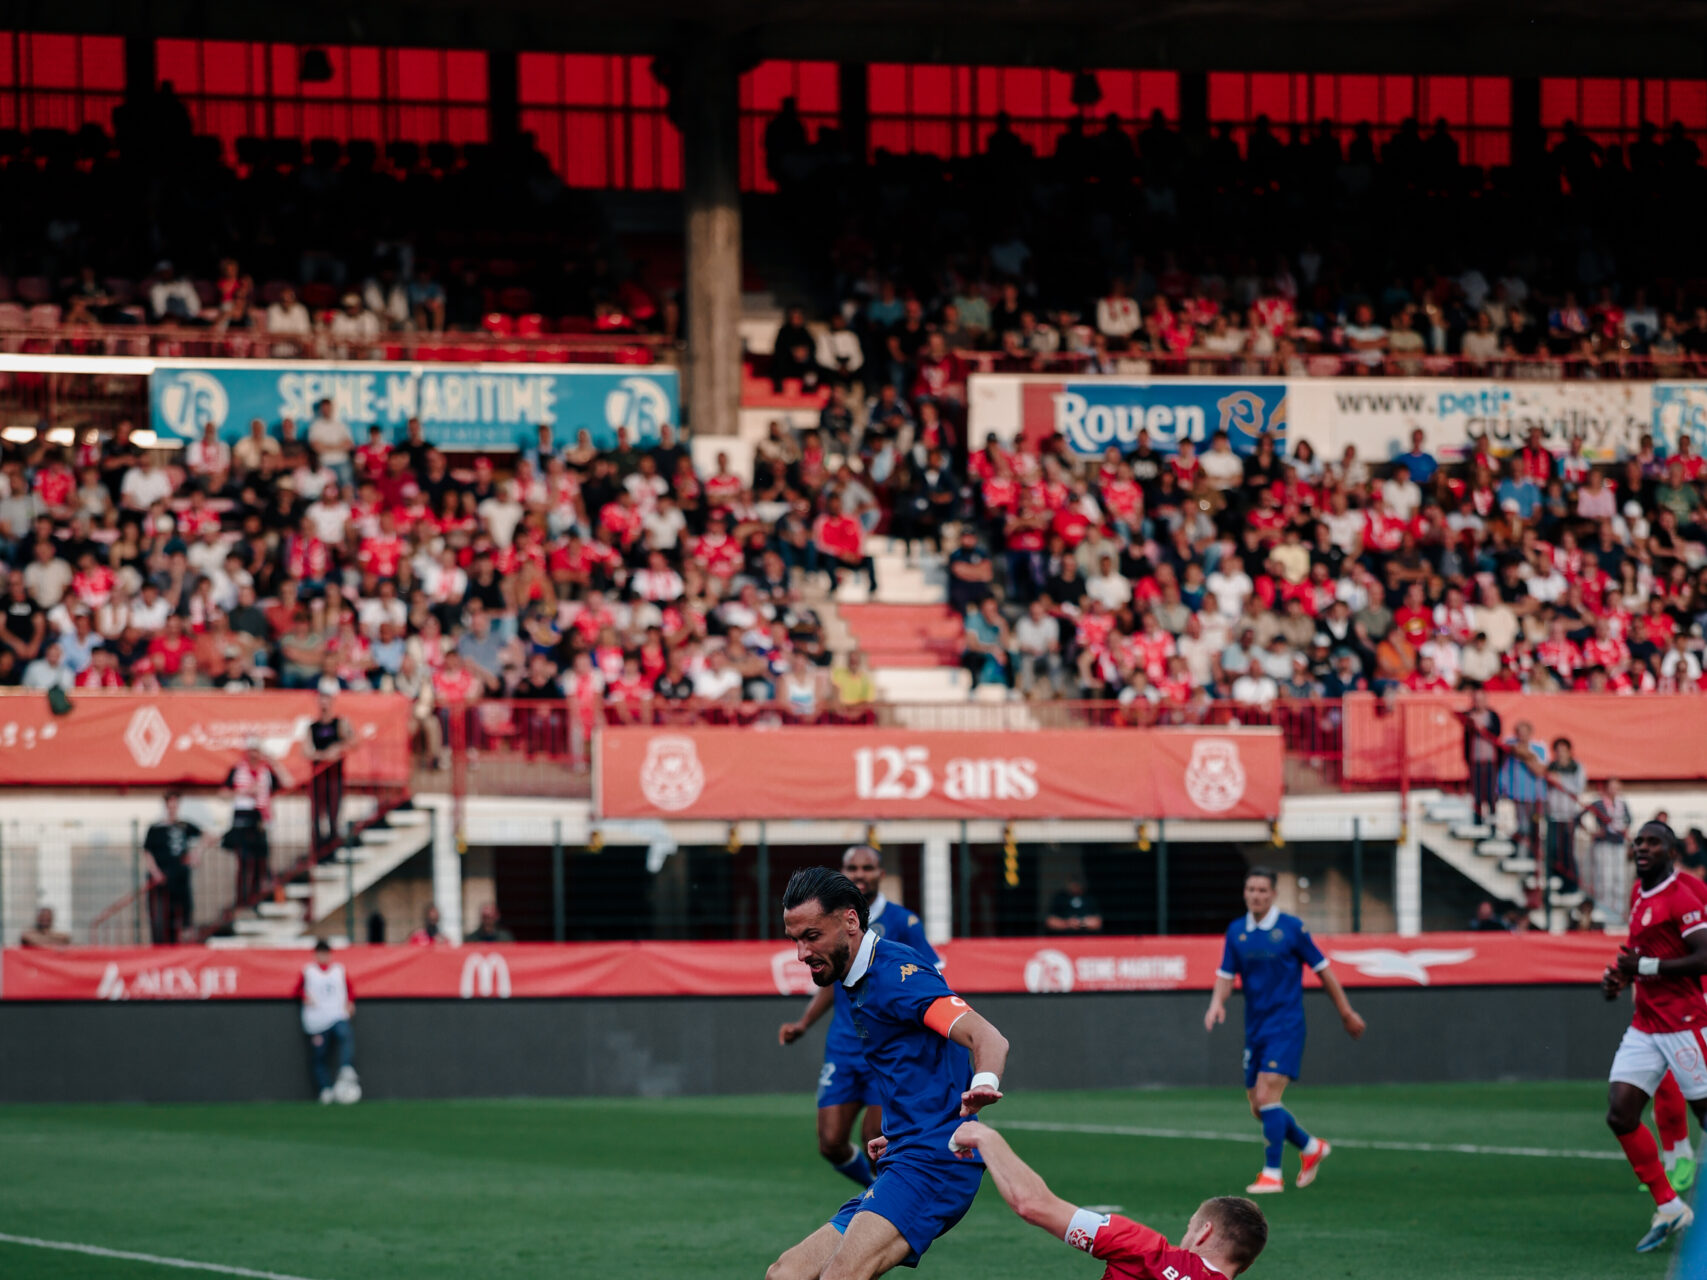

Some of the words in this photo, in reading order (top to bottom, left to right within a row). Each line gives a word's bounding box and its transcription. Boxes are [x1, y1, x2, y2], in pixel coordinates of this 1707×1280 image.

[1052, 391, 1206, 451] Rouen
[855, 746, 933, 800] 125
[943, 756, 1039, 800] ans
